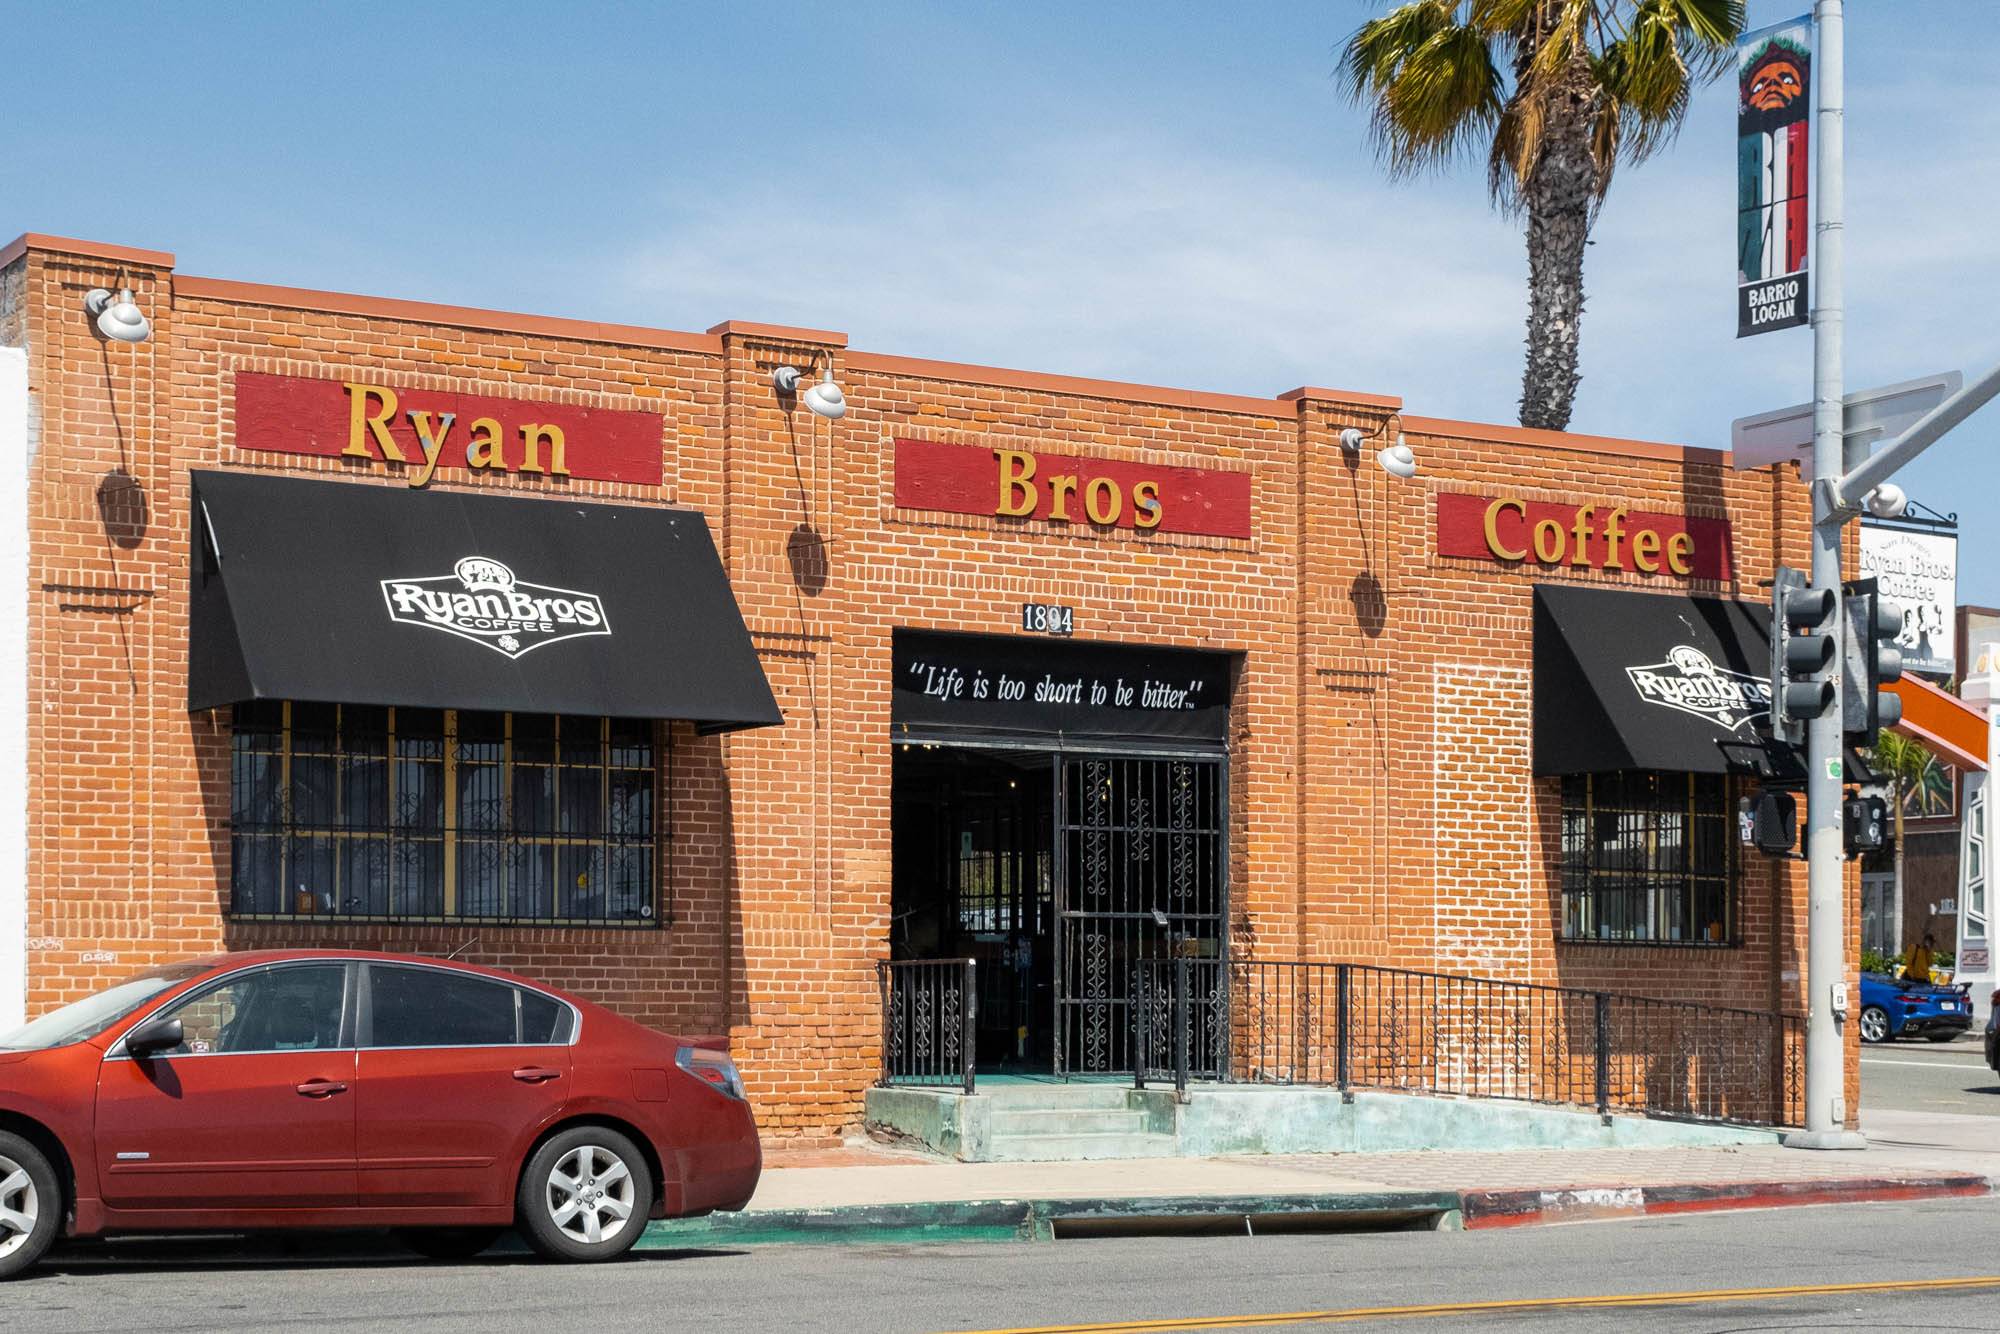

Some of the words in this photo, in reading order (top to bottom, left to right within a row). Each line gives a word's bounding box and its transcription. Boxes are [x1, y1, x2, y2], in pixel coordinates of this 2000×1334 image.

[1748, 280, 1799, 308] BARRIO
[1751, 300, 1796, 325] LOGAN
[341, 382, 571, 488] Ryan
[993, 449, 1163, 528] Bros
[1484, 498, 1696, 575] Coffee
[1859, 546, 1905, 577] Ryan
[1910, 555, 1954, 581] Bros.
[1878, 575, 1935, 602] Coffee
[456, 617, 556, 633] COFFEE
[910, 662, 964, 701] "Life
[972, 670, 990, 699] is
[997, 673, 1026, 700] too
[1034, 674, 1083, 703] short
[1090, 680, 1107, 705] to
[1115, 679, 1134, 706] be
[1685, 697, 1752, 710] COFFEE
